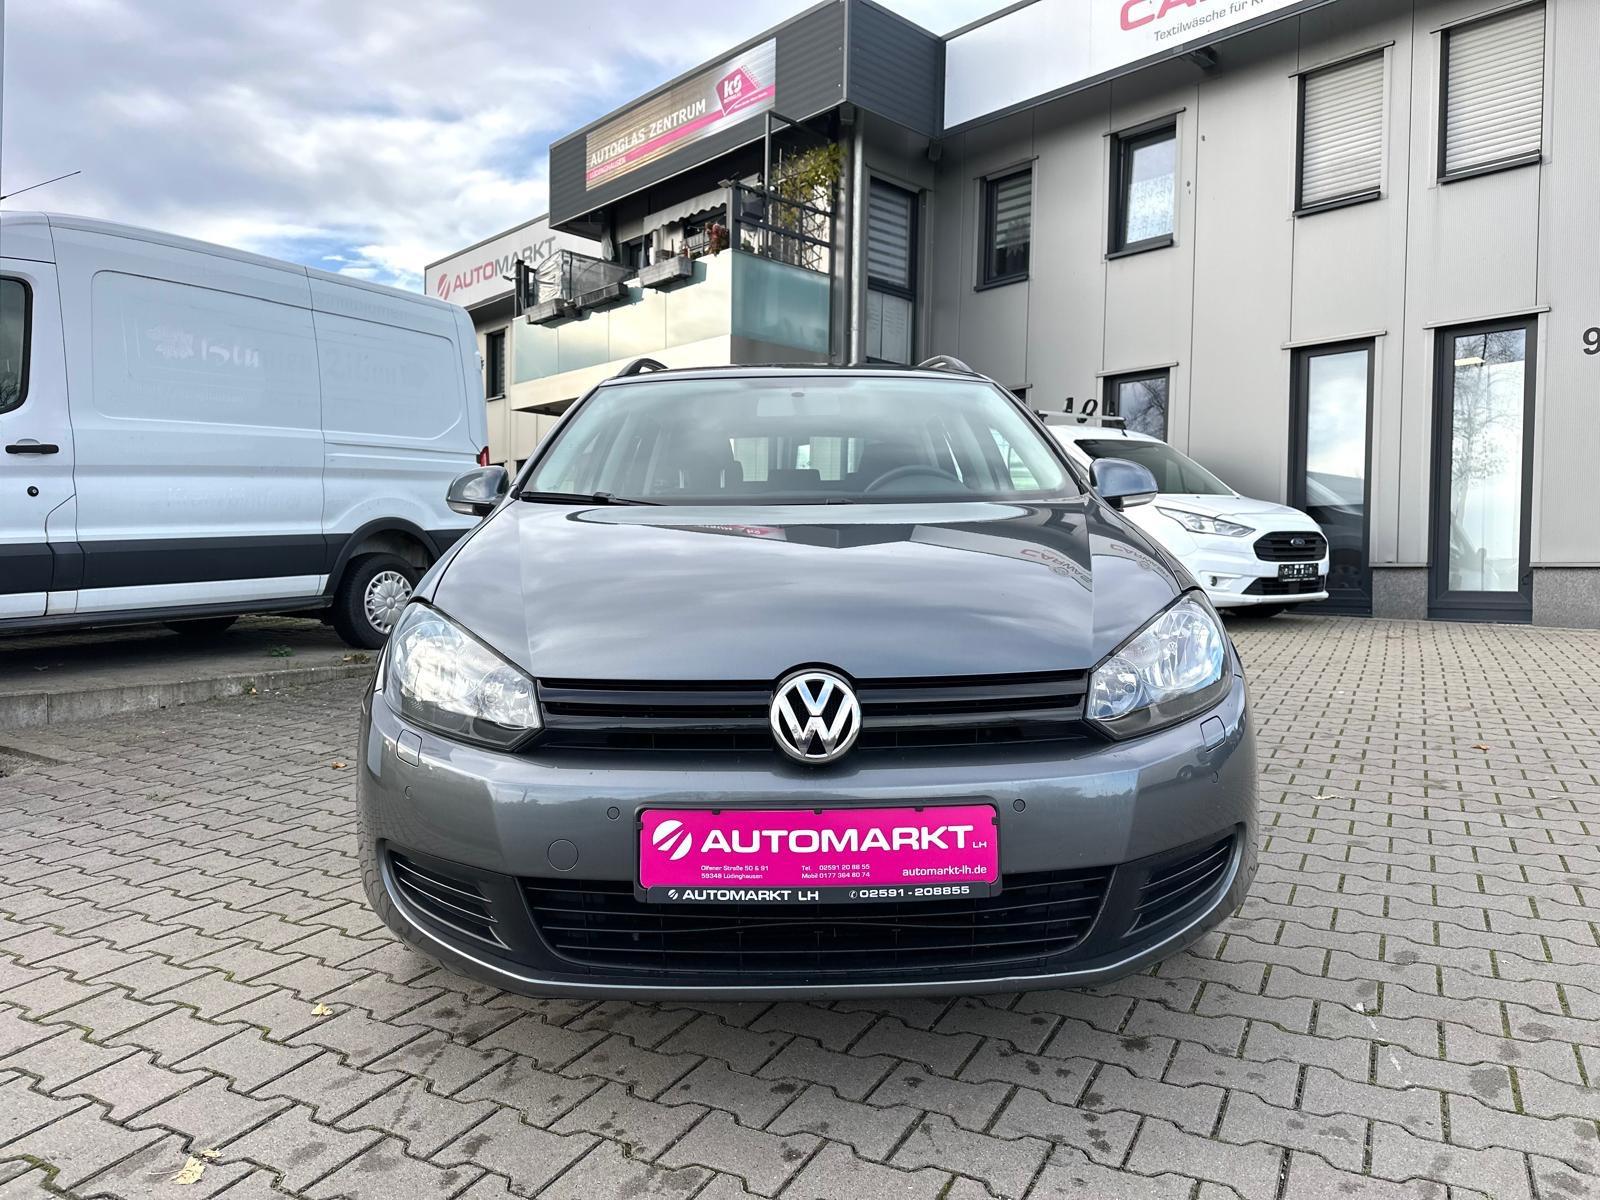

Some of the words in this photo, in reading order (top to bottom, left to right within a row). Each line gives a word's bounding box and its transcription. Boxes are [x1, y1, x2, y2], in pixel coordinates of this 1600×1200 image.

[1120, 0, 1206, 31] CA
[1153, 7, 1226, 42] Textilwäsche
[1229, 1, 1246, 15] für
[589, 127, 648, 168] AUTOGLAS
[649, 98, 706, 138] ZENTRUM
[452, 236, 556, 292] AUTOMARKT
[700, 824, 973, 854] AUTOMARKT
[972, 840, 988, 849] LH
[902, 864, 987, 877] automarkt-lh.de
[682, 889, 791, 901] AUTOMARKT
[798, 890, 819, 901] LH
